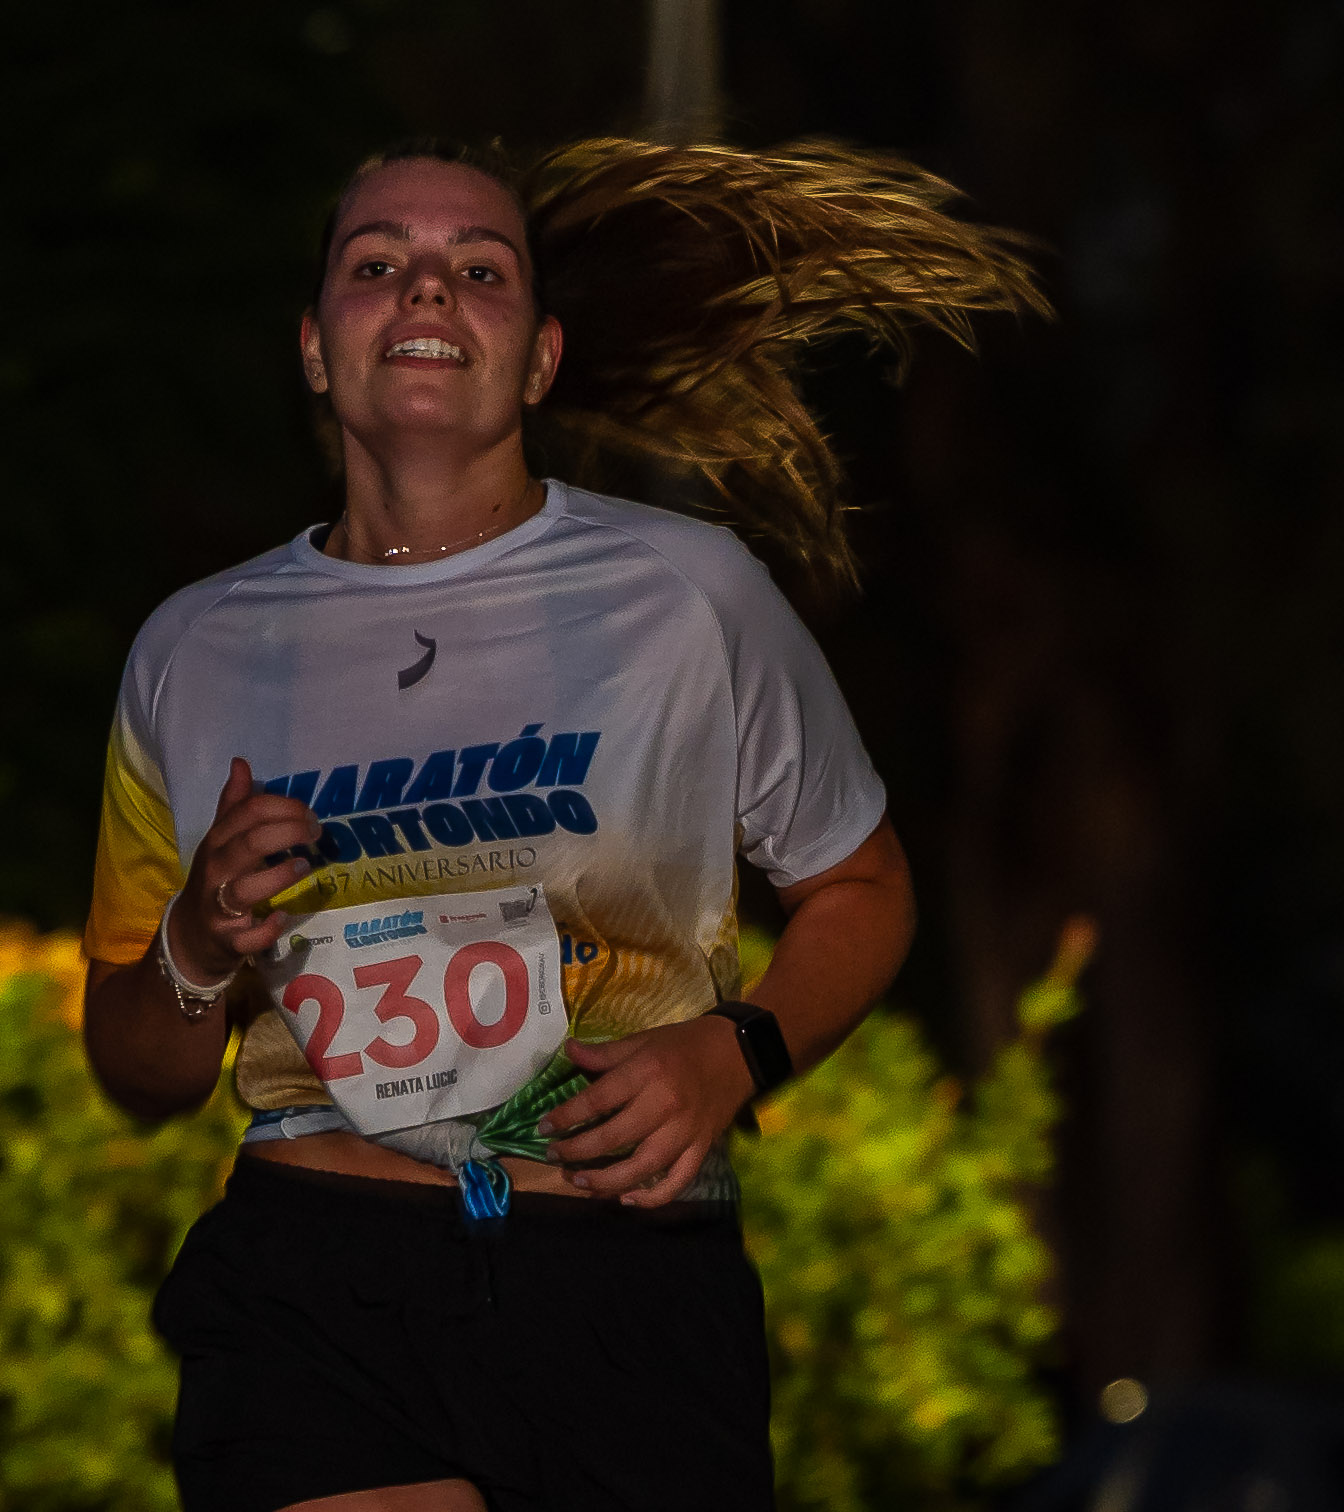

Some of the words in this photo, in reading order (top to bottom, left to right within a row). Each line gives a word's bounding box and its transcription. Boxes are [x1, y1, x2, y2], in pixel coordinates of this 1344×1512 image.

[264, 790, 598, 868] ORTONDO
[361, 847, 536, 889] ANIVERSARIO
[282, 941, 529, 1081] 230
[376, 1076, 424, 1099] RENATA
